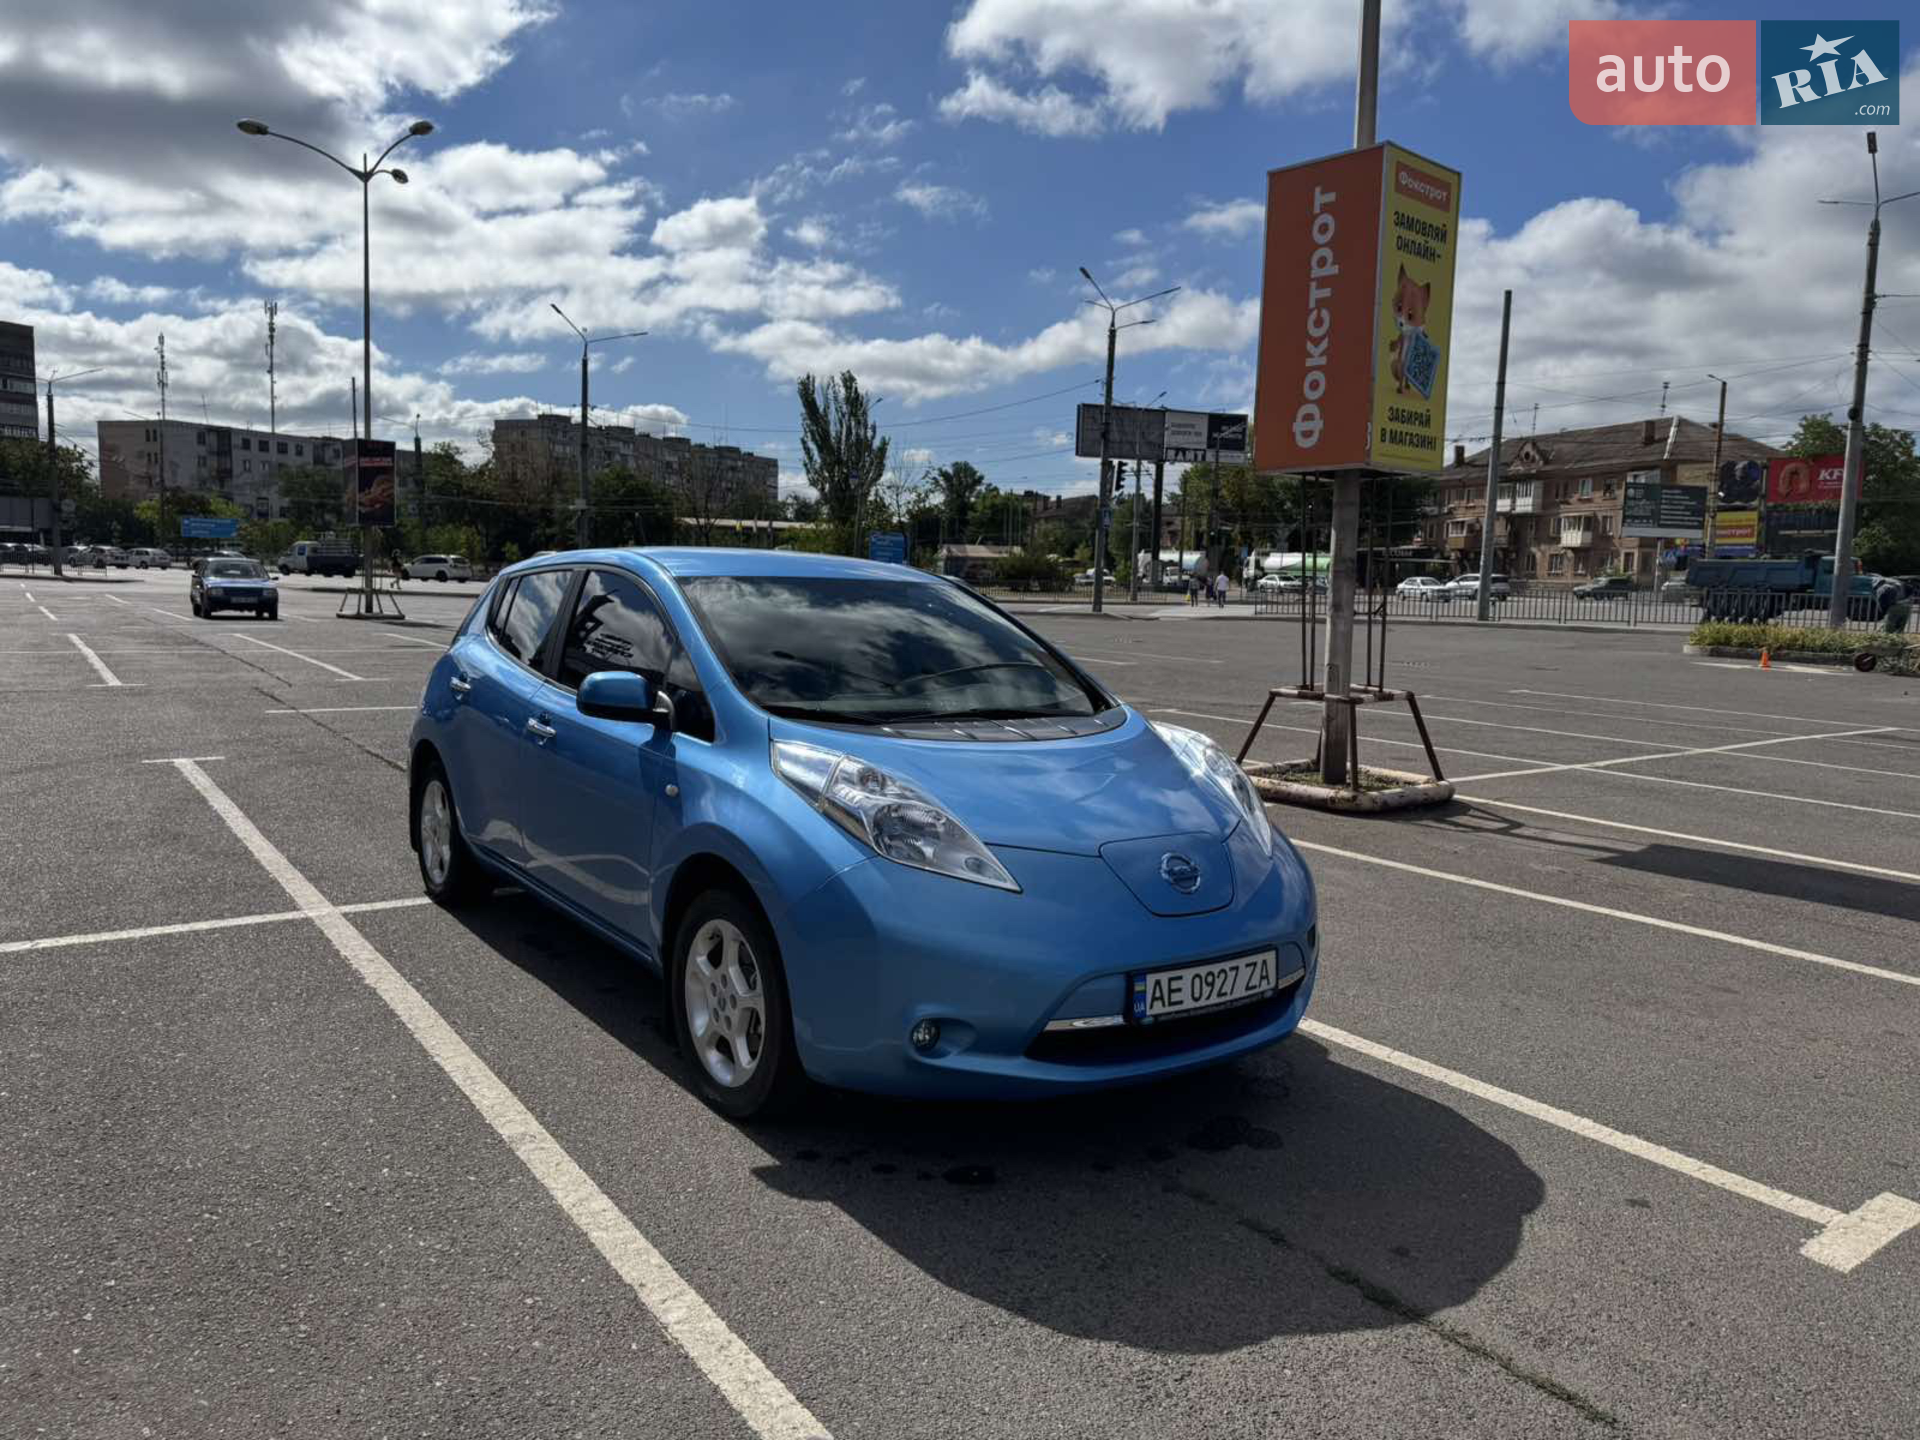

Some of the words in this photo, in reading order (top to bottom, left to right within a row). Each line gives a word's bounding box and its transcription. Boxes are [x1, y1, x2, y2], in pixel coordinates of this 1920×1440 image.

[1400, 171, 1448, 202] Фокстрот
[1393, 210, 1448, 244] ЗАМОВЛЯЙ
[1396, 234, 1442, 264] ОНЛАЙН-
[1292, 185, 1339, 449] Фокстрот
[1387, 405, 1431, 429] ЗАБИРАЙ
[1380, 427, 1387, 443] В
[1818, 467, 1844, 480] KF
[1150, 975, 1184, 1010] AE
[1190, 965, 1240, 1003] 0927
[1245, 958, 1271, 992] ZA
[1133, 1002, 1146, 1015] UA
